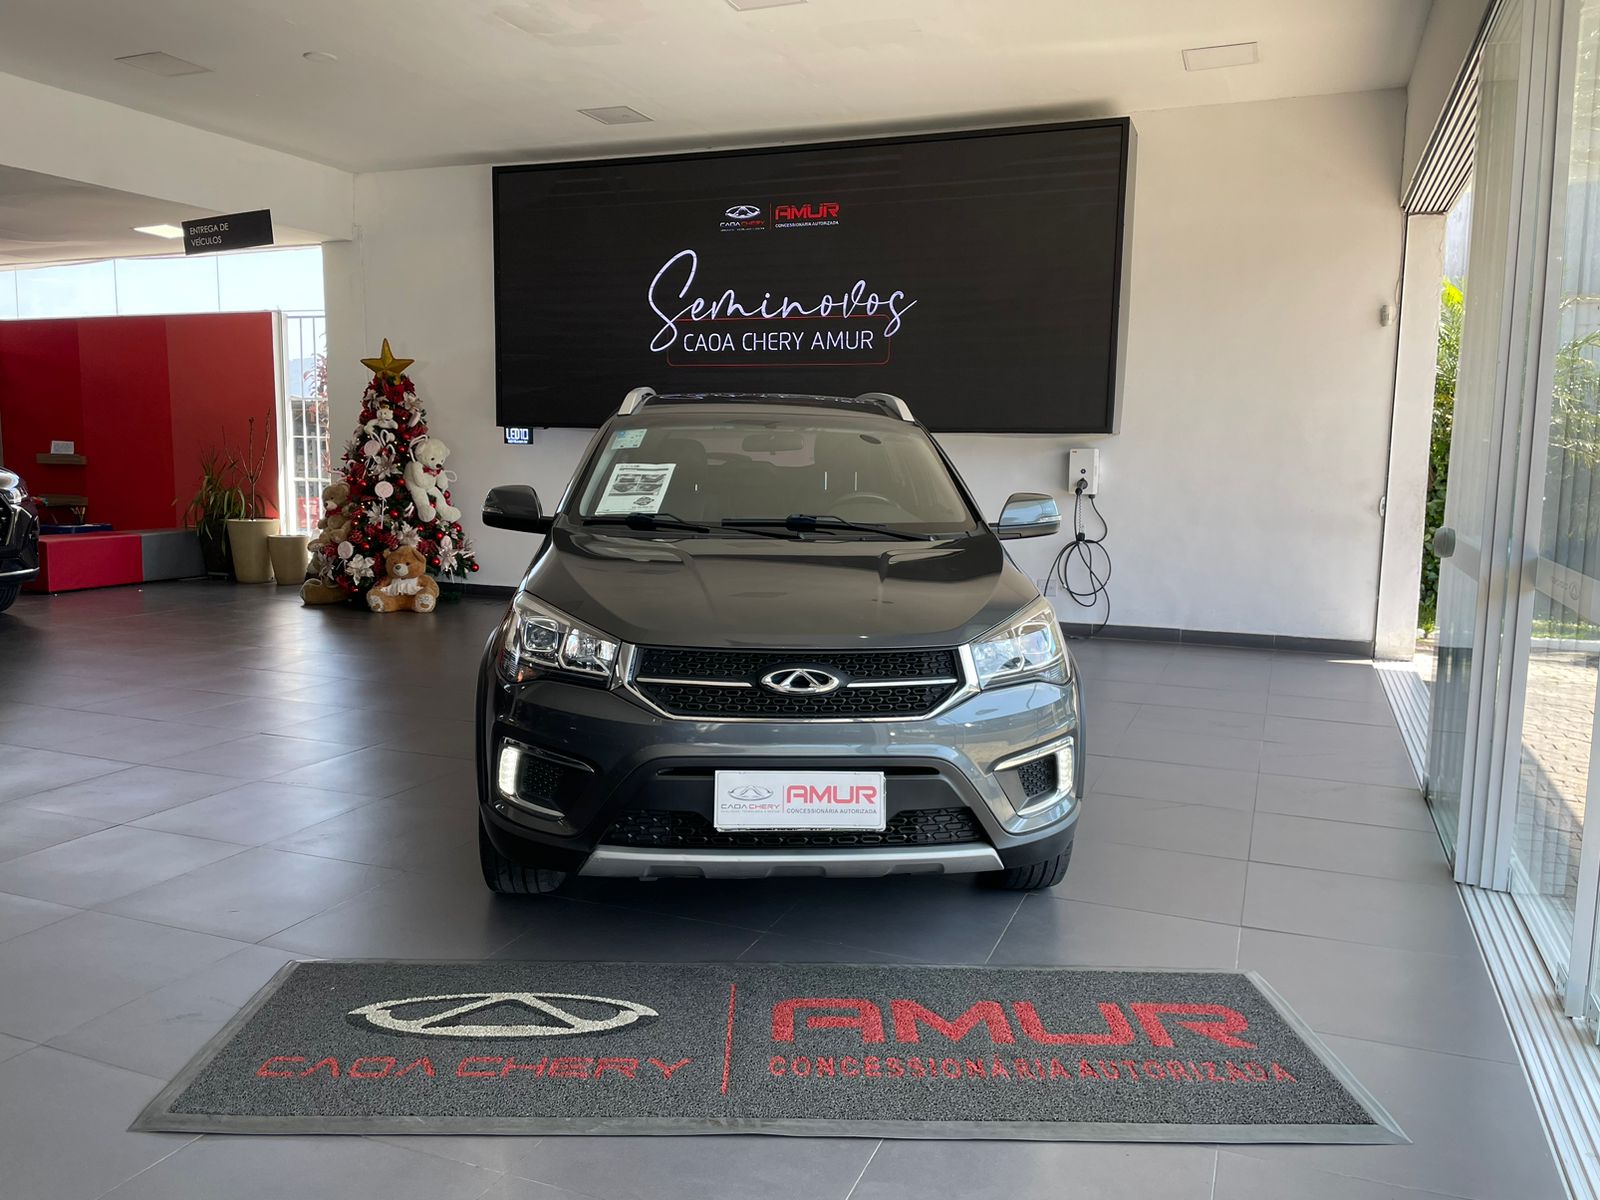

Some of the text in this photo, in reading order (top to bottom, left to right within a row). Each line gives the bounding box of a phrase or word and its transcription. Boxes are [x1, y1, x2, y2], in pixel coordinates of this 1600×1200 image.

[775, 202, 840, 220] AMUR
[189, 222, 229, 235] ENTREGA DE
[190, 236, 222, 247] VEÍCULOS
[648, 249, 918, 352] Seminovos
[683, 330, 874, 352] CAOA CHERY AMUR
[786, 785, 878, 804] AMUR
[786, 806, 839, 814] CONCESSIONÁRIA
[771, 997, 1258, 1049] AMUR
[255, 1056, 692, 1080] CAOA CHERY
[768, 1053, 1298, 1085] CONCESSIONÁRIA AUTORIZADA
